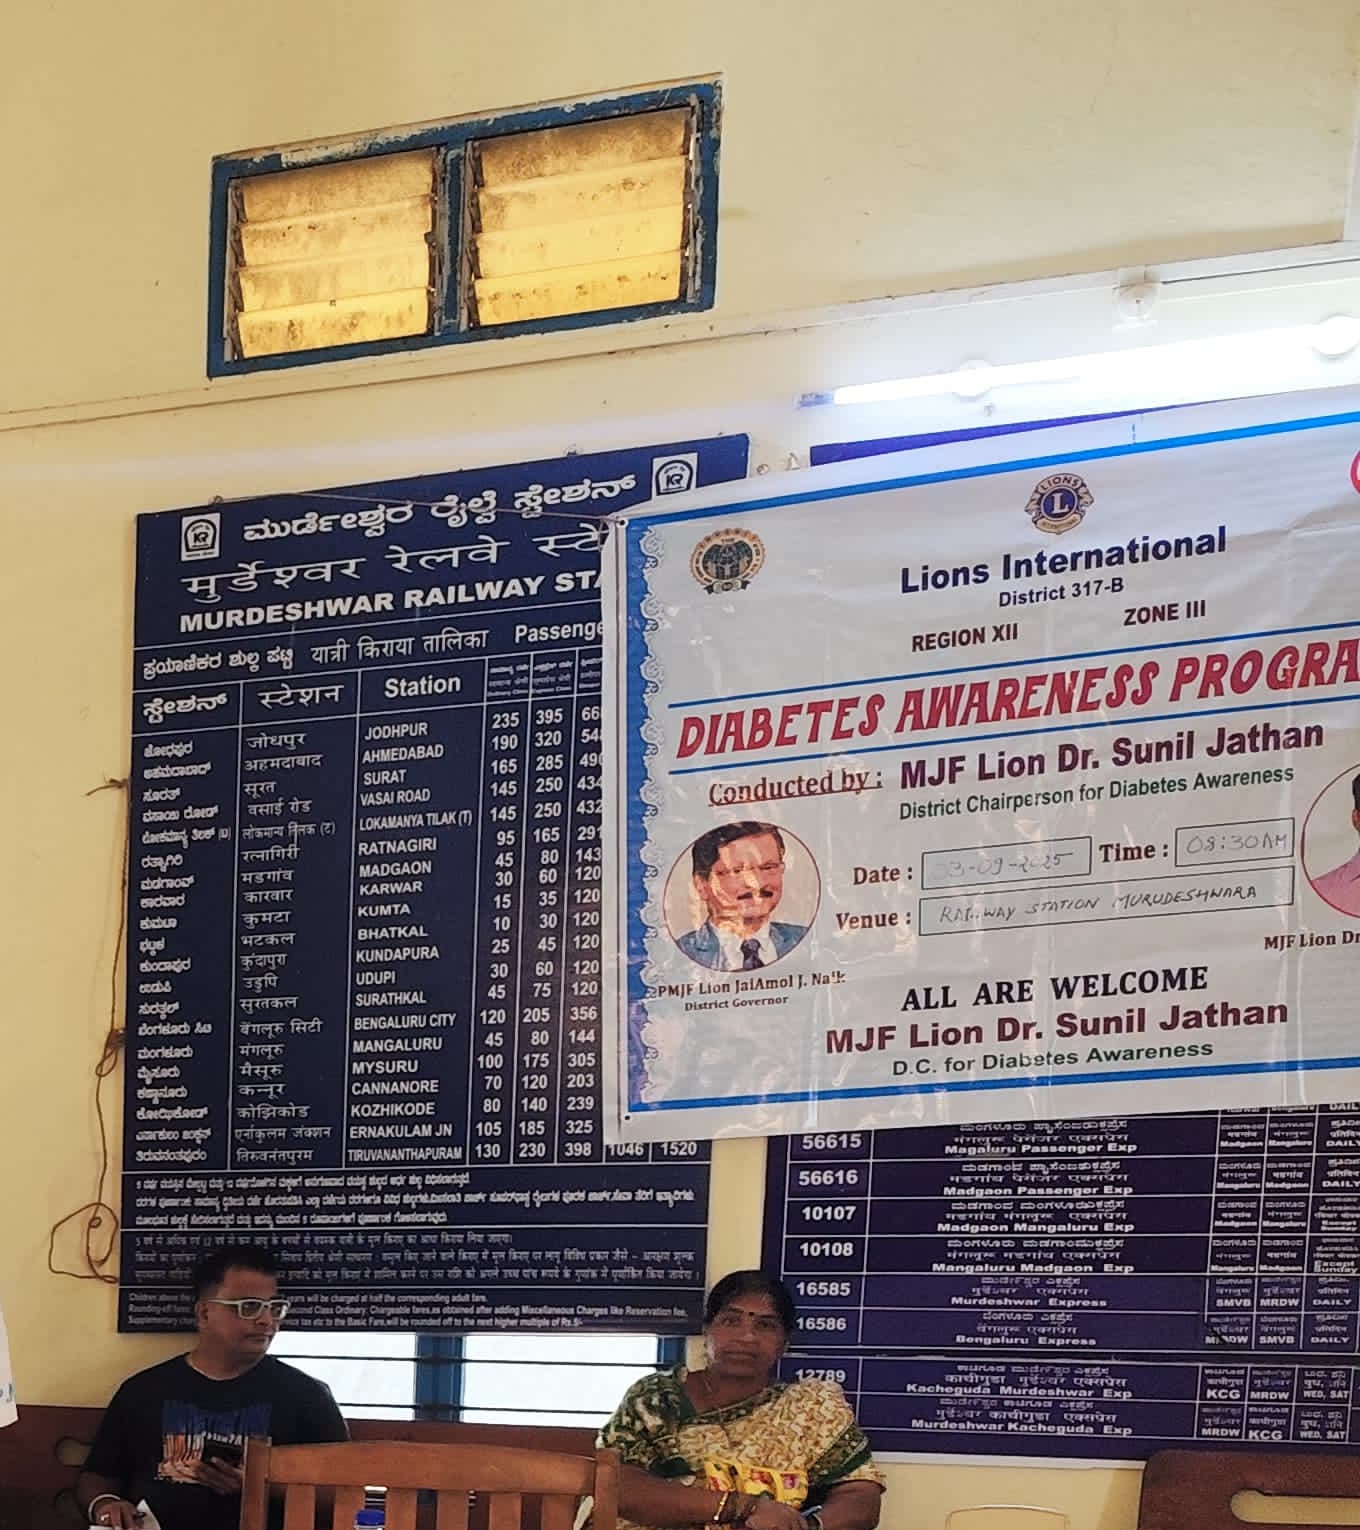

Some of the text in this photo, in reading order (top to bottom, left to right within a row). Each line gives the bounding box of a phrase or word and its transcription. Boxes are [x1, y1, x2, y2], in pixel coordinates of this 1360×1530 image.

[1041, 476, 1079, 490] LIONS
[384, 535, 510, 573] रेलवे
[901, 525, 1226, 594] Lions International
[999, 577, 1124, 607] District 317-B
[180, 575, 544, 633] MURDESHWAR RAILWAY
[1124, 600, 1206, 626] ZONE III
[311, 628, 489, 664] यात्री किराया तालिका
[912, 623, 1019, 652] REGION XII
[384, 675, 461, 698] Station
[257, 683, 344, 709] स्टेशन
[677, 694, 885, 759] DIABETES
[895, 660, 1160, 733] AWARENESS
[364, 709, 563, 741] JODHPUR 235 395
[362, 744, 444, 764] AHMEDABAD
[901, 722, 1324, 791] MJF Lion Dr. Sunil Jathan
[363, 769, 407, 786] SURAT
[708, 767, 870, 807] Conducted by
[899, 765, 1294, 821] District Chairperson for Diabetes Awareness
[360, 788, 431, 806] VASAI ROAD
[359, 811, 457, 832] LOKAMANYA TILAK
[358, 838, 437, 856] RATNAGIRI
[1099, 843, 1156, 863] Time
[359, 861, 432, 877] MADGAON
[853, 867, 901, 885] Date
[359, 881, 423, 896] KARWAR
[358, 903, 411, 917] KUMTA
[1024, 897, 1100, 915] STATION
[835, 911, 898, 930] Venue
[358, 925, 428, 941] BHATKAL
[1264, 932, 1336, 950] MJF Lion
[356, 947, 440, 963] KUNDAPURA
[356, 971, 396, 985] UDUPI
[658, 980, 730, 998] PMJF Lion
[901, 965, 1209, 1014] ALL ARE WELCOME
[355, 991, 427, 1007] SURATHKAL
[684, 995, 789, 1012] District Governor
[354, 1006, 597, 1031] BENGALURU CITY 120 205 356
[825, 998, 1289, 1056] MJF Lion Dr. Sunil Jathan
[353, 1037, 443, 1053] MANGALURU
[352, 1059, 419, 1075] MYSURU
[892, 1040, 1213, 1077] D.C. for Diabetes Awareness
[351, 1080, 440, 1096] CANNANORE
[351, 1102, 435, 1118] KOZHIKODE
[349, 1123, 453, 1139] ERNAKULAM JN
[802, 1133, 862, 1150] 56615
[348, 1142, 697, 1162] TIRUVANANTHAPURAM 130 230 398 1520
[798, 1170, 858, 1186] 56616
[802, 1206, 857, 1221] 10107
[799, 1242, 854, 1257] 10108
[796, 1281, 851, 1296] 16585
[951, 1296, 1040, 1306] Murdeshwar
[796, 1317, 847, 1331] 16586
[1206, 1389, 1241, 1400] KCG
